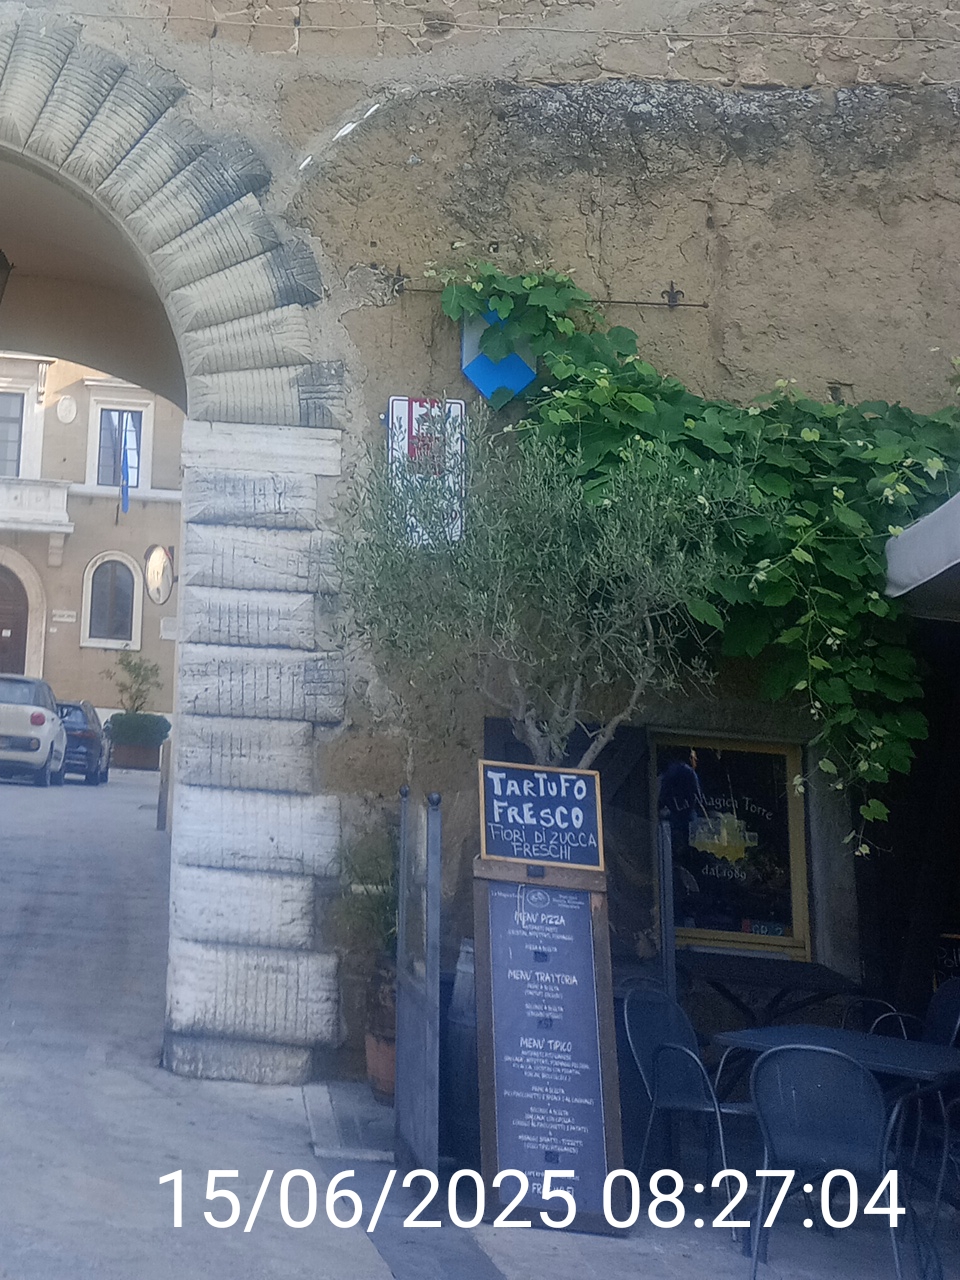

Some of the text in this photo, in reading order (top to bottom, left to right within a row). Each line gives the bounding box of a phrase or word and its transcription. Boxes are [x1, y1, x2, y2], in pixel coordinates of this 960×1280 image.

[487, 770, 587, 800] TARTUFO
[493, 799, 584, 829] FRESCO
[742, 796, 774, 820] Torre
[511, 842, 571, 861] FRESCHI
[549, 831, 597, 848] ZUCCA
